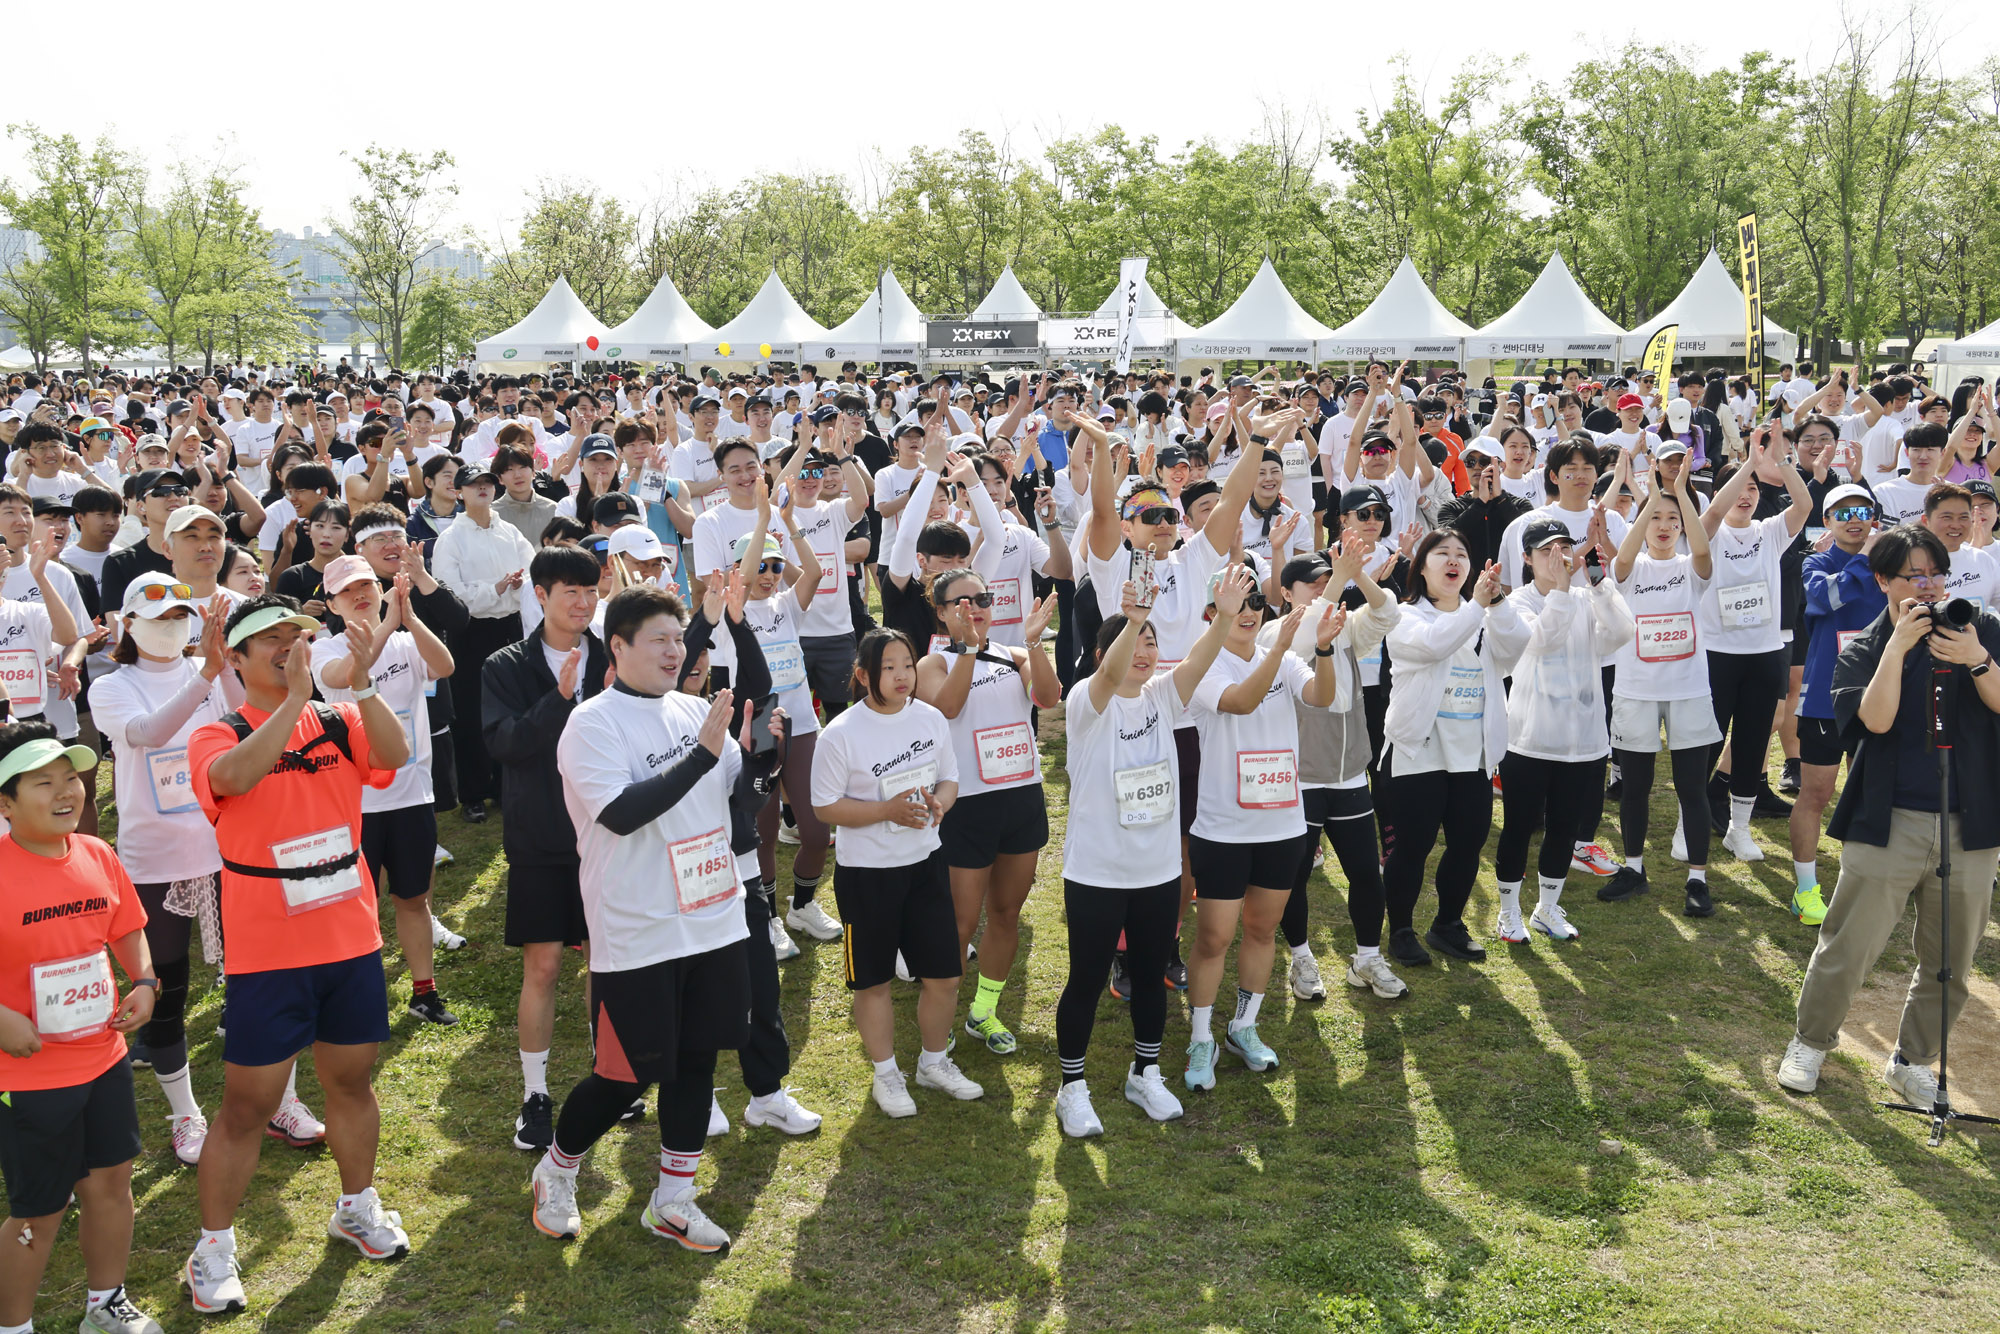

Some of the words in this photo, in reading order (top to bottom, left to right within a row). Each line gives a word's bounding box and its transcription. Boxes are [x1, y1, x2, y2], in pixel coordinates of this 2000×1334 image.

[974, 329, 1011, 341] REXY
[1097, 328, 1118, 338] RE
[1204, 344, 1251, 354] 김정문알로에
[1502, 343, 1545, 353] 썬바디태닝
[1286, 459, 1305, 467] 6288
[1002, 545, 1019, 556] Run
[1944, 577, 1963, 589] ning
[1962, 572, 1982, 582] Run
[1724, 603, 1732, 611] W
[1734, 596, 1764, 610] 6291
[1743, 616, 1756, 624] C-7
[1643, 633, 1652, 641] W
[1653, 629, 1688, 642] 3228
[387, 661, 410, 676] Run
[768, 657, 799, 672] 8237
[1454, 686, 1485, 698] 8582
[980, 731, 1004, 741] BURNING
[1004, 729, 1015, 737] RUN
[155, 752, 185, 764] BURNING
[646, 743, 682, 769] Burning
[681, 735, 699, 749] Ru
[871, 749, 912, 777] Burning
[911, 739, 935, 755] Run
[985, 750, 995, 760] W
[996, 742, 1030, 760] 3659
[316, 753, 340, 769] RUN
[160, 775, 172, 786] W
[1245, 774, 1256, 784] W
[1257, 771, 1292, 785] 3456
[1124, 791, 1135, 801] W
[1136, 781, 1171, 801] 6387
[1127, 812, 1147, 822] D-30
[280, 840, 311, 855] BURNING
[311, 836, 328, 848] RUN
[676, 843, 703, 856] BURNING
[683, 867, 694, 879] M
[696, 854, 729, 877] 1853
[22, 899, 84, 927] BURNING
[84, 896, 109, 913] RUN
[40, 964, 77, 981] BURNING
[77, 962, 93, 973] RUN
[45, 993, 60, 1007] M
[63, 979, 109, 1007] 2430
